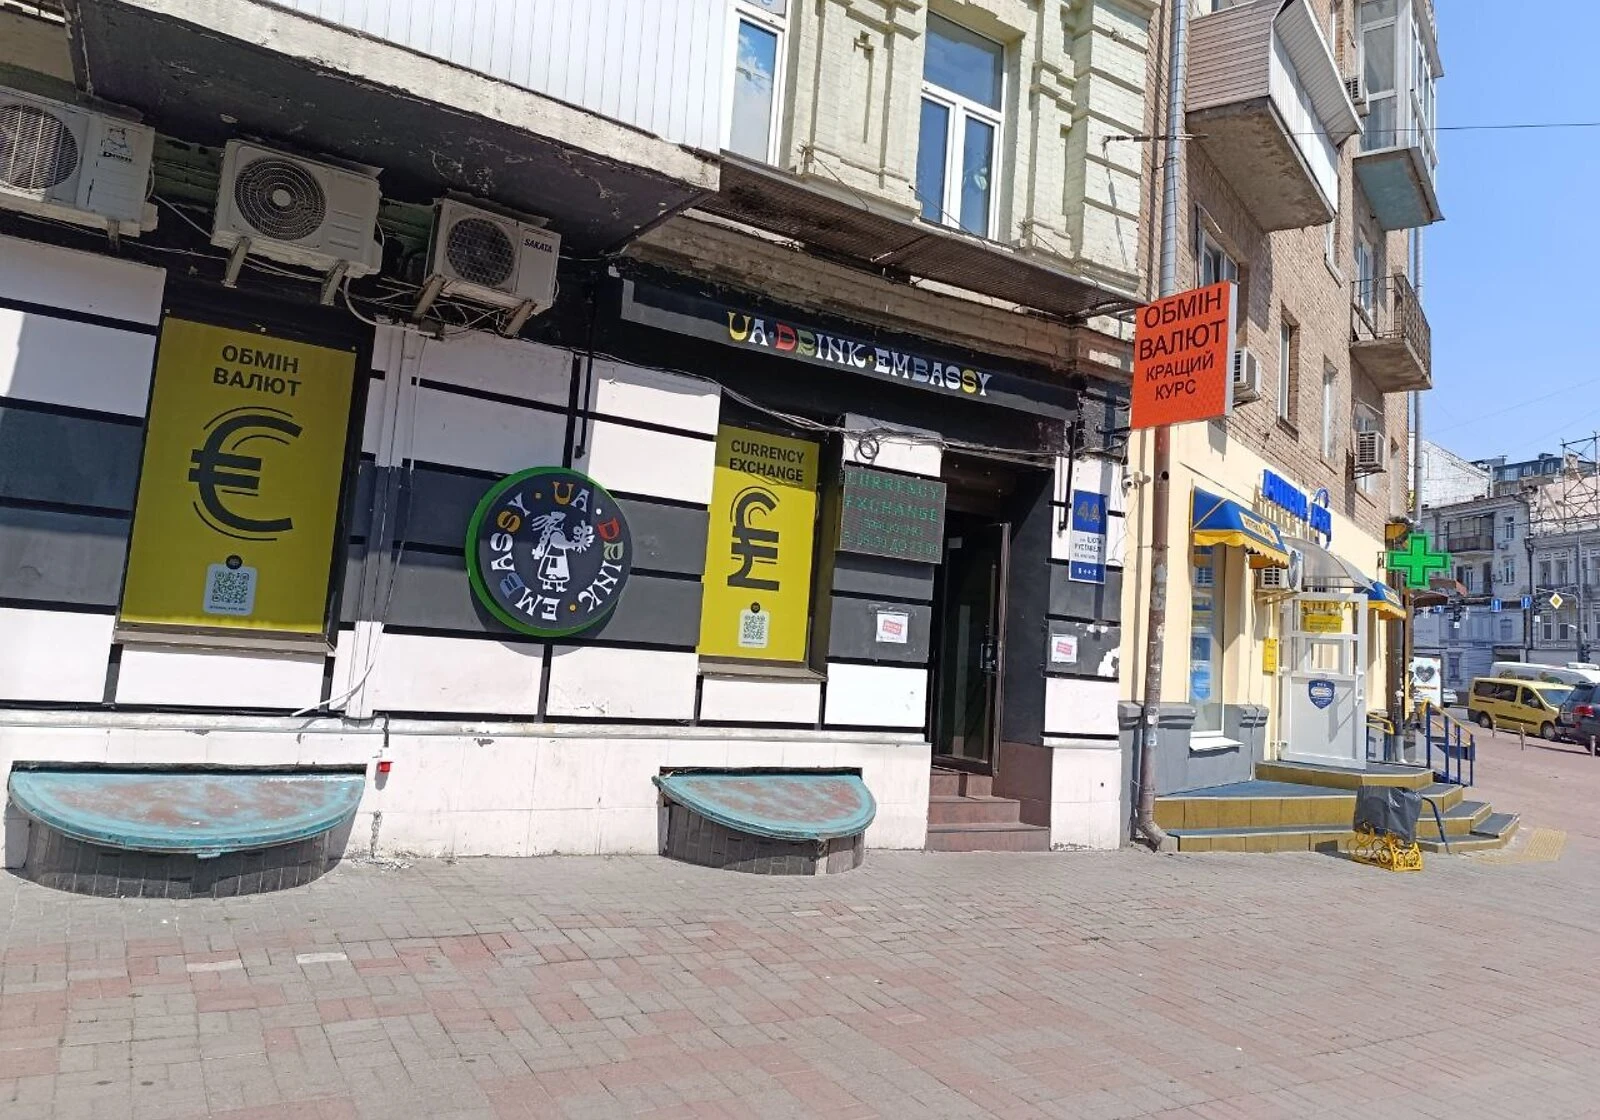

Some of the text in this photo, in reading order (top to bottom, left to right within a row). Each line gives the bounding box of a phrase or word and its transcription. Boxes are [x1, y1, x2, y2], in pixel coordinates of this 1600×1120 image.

[523, 239, 552, 253] SAKATA
[1144, 288, 1222, 329] ОБМІН
[1140, 319, 1226, 361] ВАЛЮТ
[222, 345, 299, 374] ОБМІН
[1146, 350, 1214, 382] КРАЩИЙ
[213, 367, 302, 396] ВАЛЮТ
[1155, 379, 1196, 400] КУРС
[731, 439, 805, 464] CURRENCY
[729, 457, 804, 482] EXCHANGE
